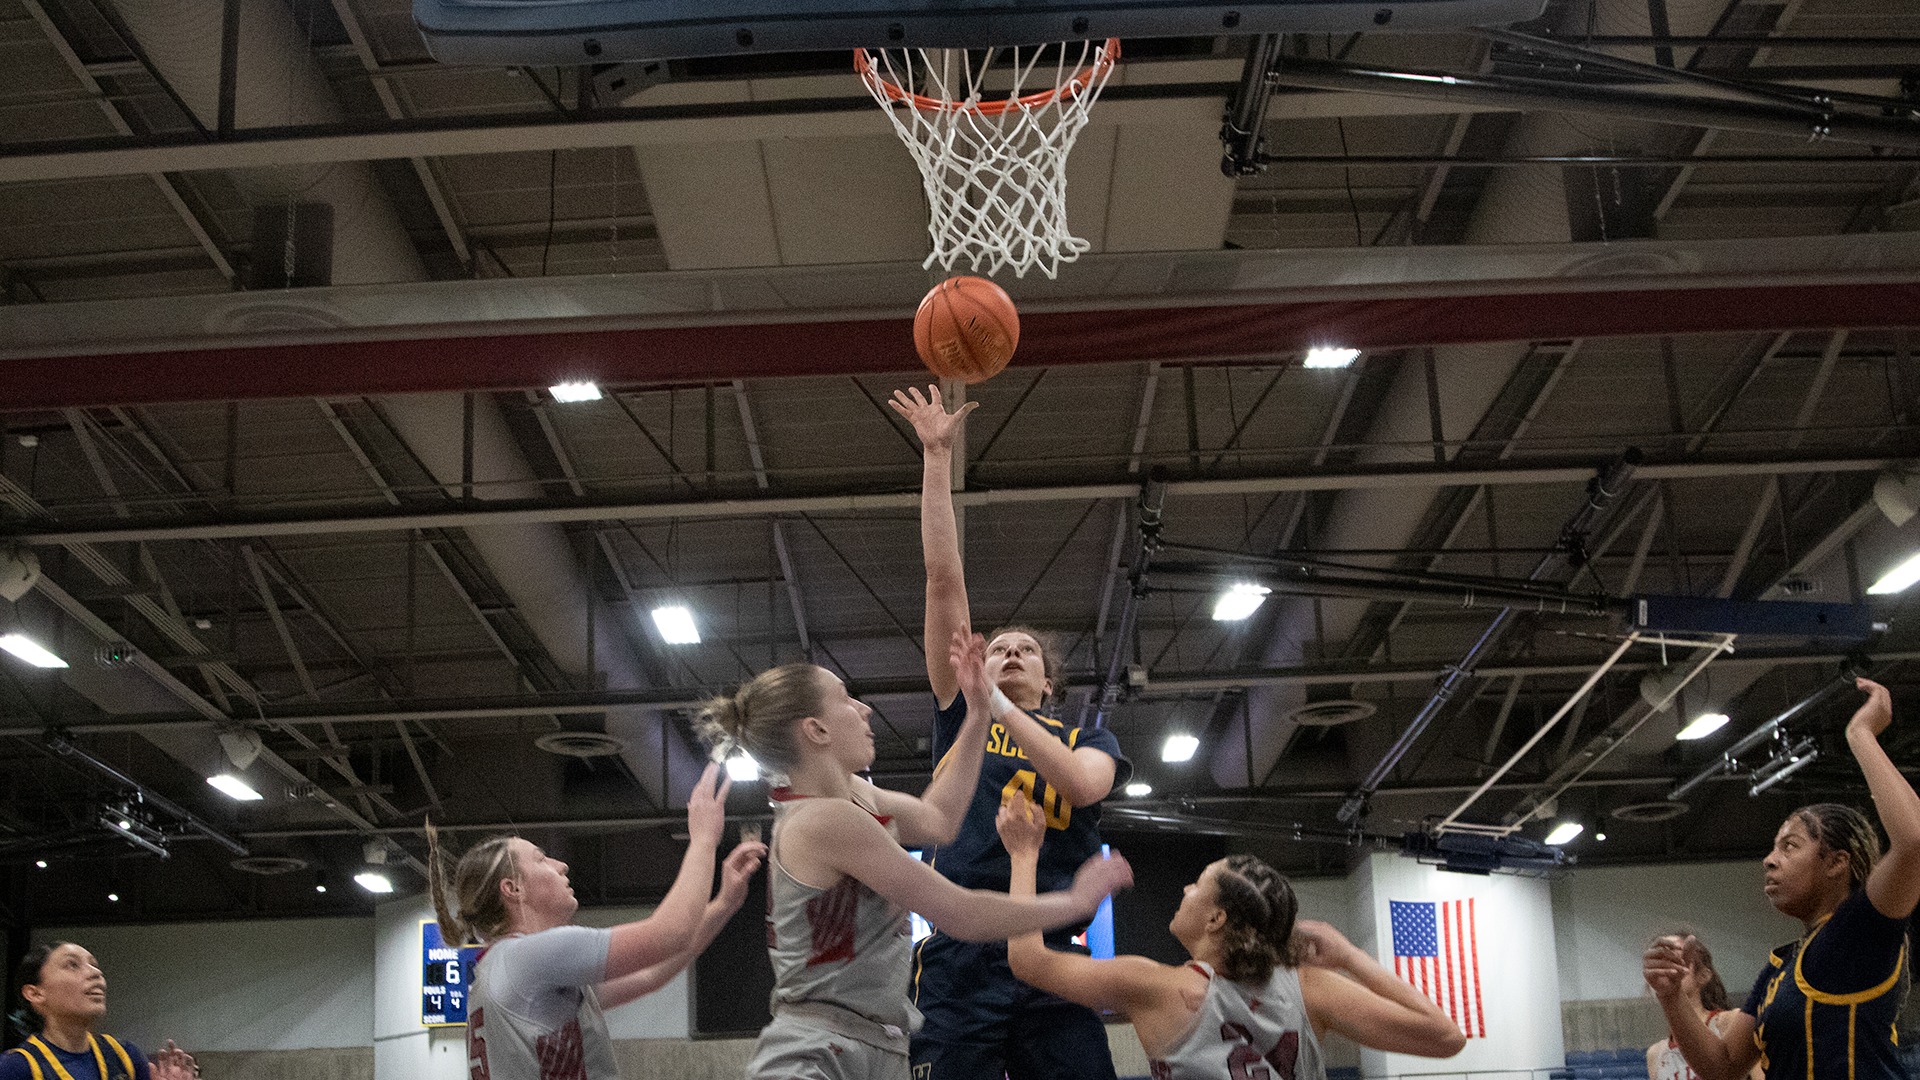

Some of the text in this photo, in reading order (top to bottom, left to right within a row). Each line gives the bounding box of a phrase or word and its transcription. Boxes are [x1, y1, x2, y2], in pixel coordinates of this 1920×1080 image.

[428, 948, 459, 961] HOME
[446, 961, 460, 984] 6
[423, 985, 446, 995] FOULS
[431, 995, 442, 1010] 4
[451, 998, 460, 1009] 4
